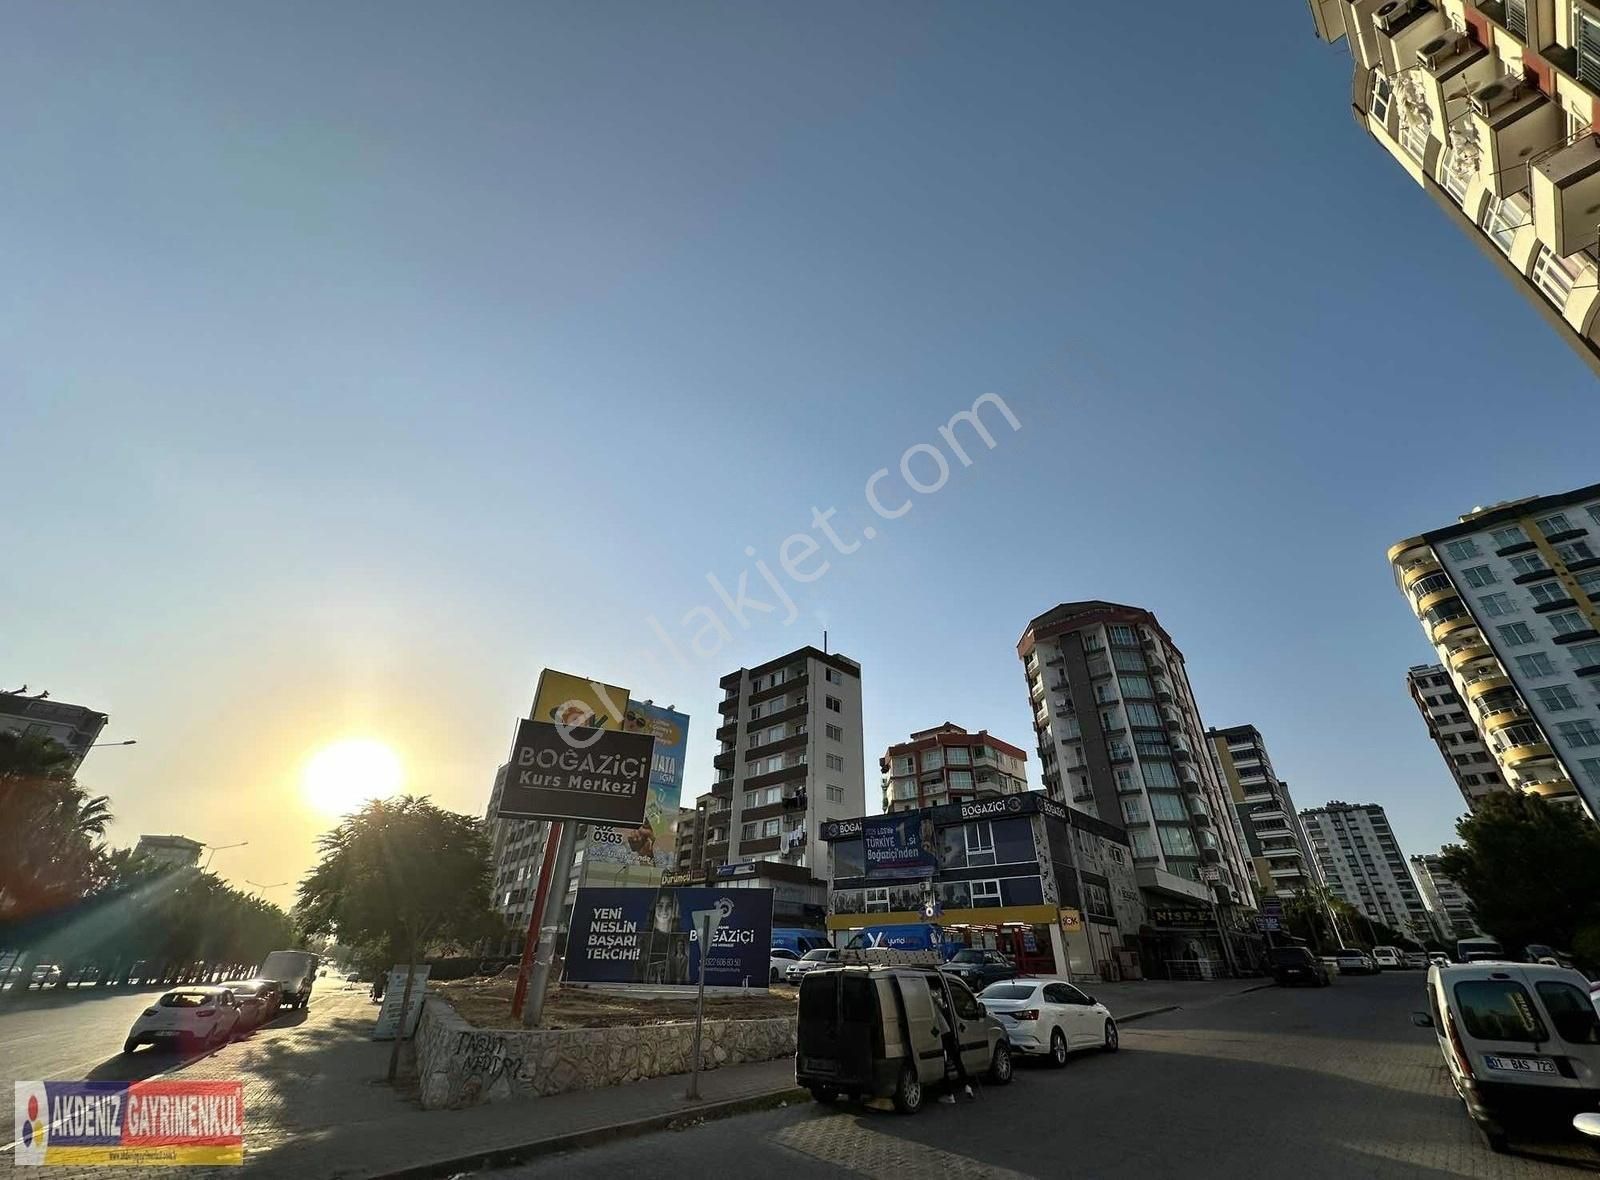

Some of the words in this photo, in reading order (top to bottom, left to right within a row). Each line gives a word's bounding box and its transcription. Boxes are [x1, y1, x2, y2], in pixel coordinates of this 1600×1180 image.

[519, 771, 561, 787] Kurs
[568, 775, 637, 795] Merkezi
[594, 831, 623, 844] 0303
[587, 935, 637, 949] BAŞARI
[1491, 1058, 1503, 1068] 01
[1510, 1059, 1530, 1070] BAS
